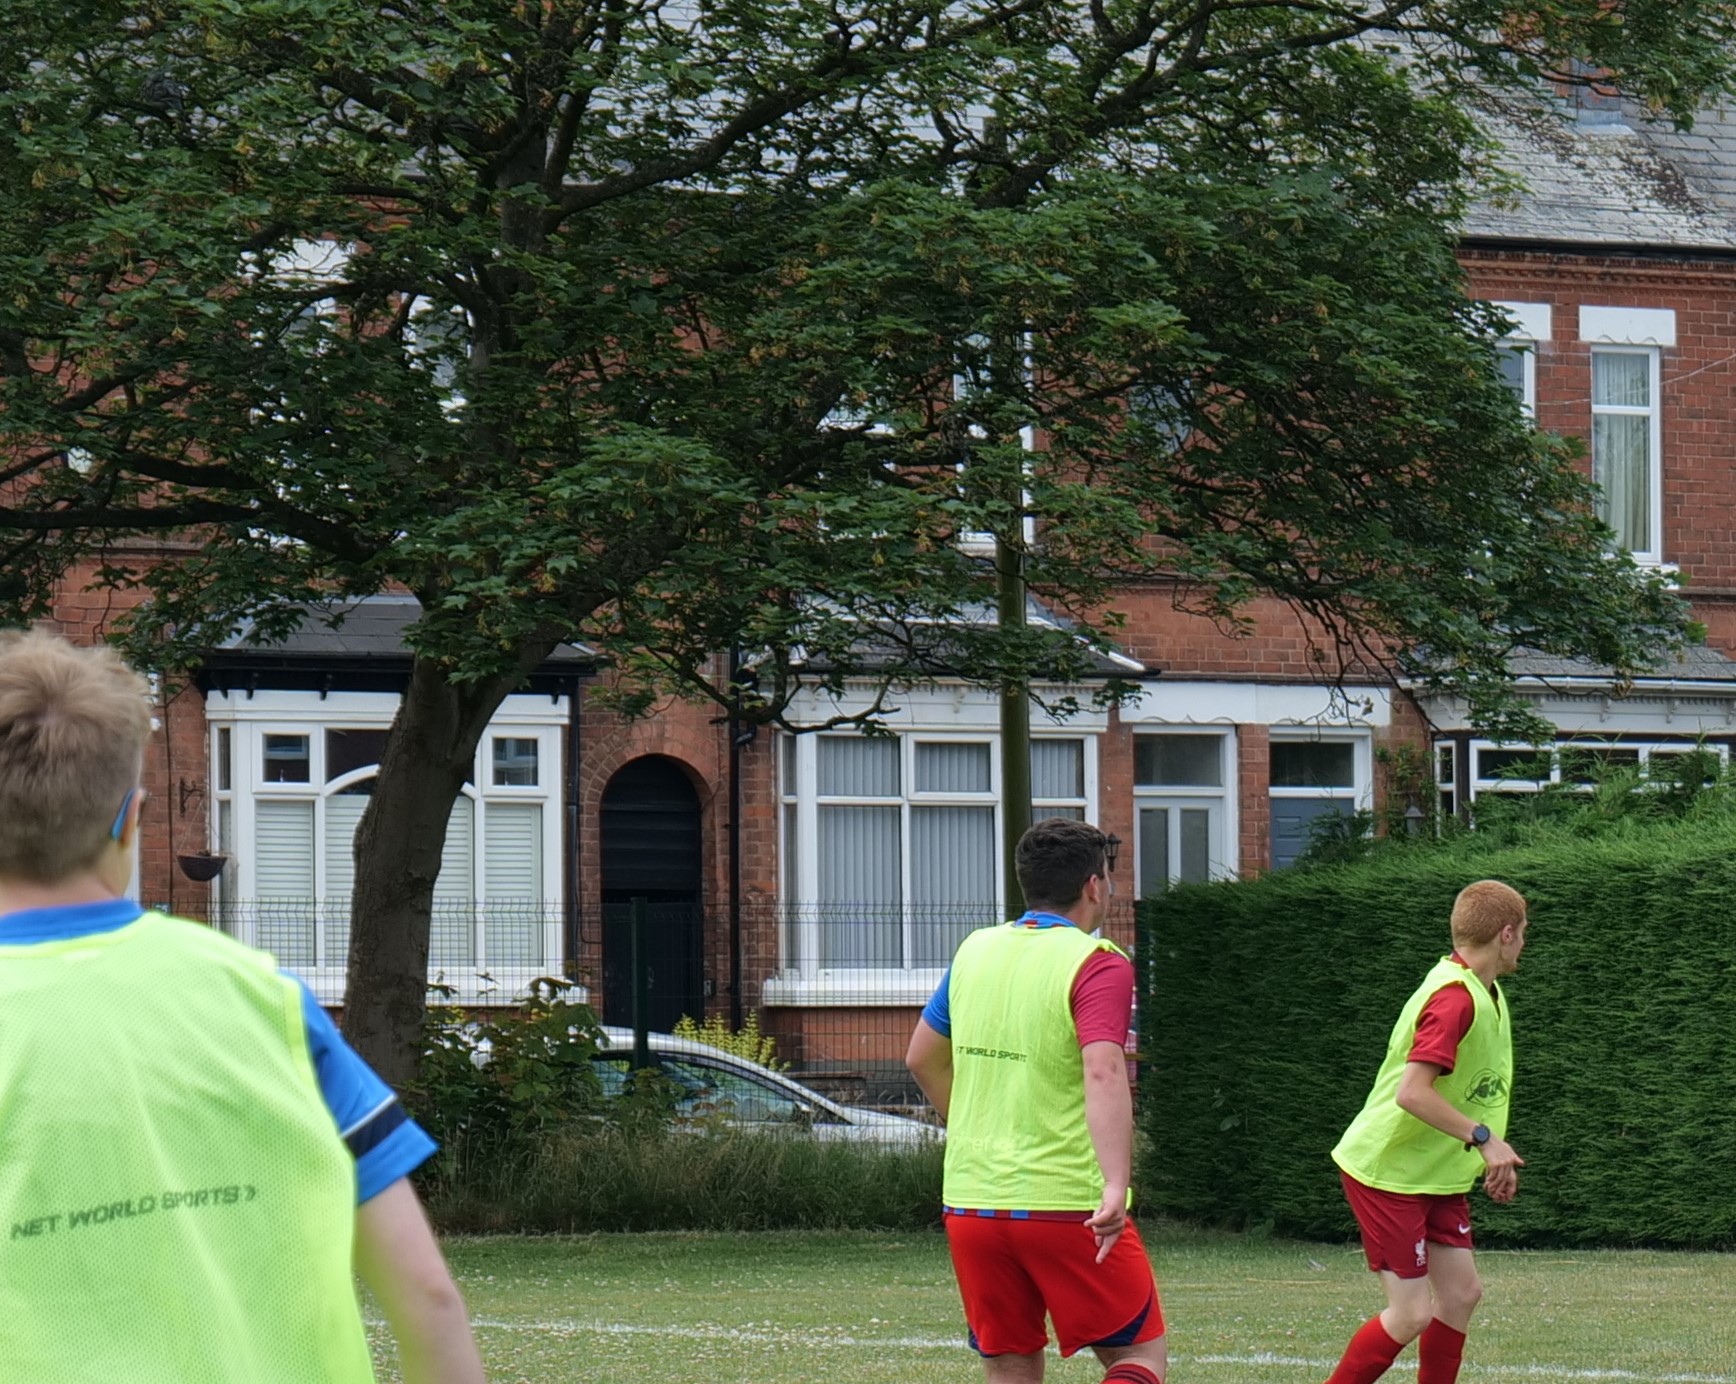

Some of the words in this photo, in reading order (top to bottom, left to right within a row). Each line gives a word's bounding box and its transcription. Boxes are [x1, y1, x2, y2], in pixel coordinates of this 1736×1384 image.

[966, 1047, 996, 1058] WORLD
[10, 1213, 62, 1240] NET
[68, 1194, 157, 1230] WORLD
[161, 1184, 241, 1210] SPORTS
